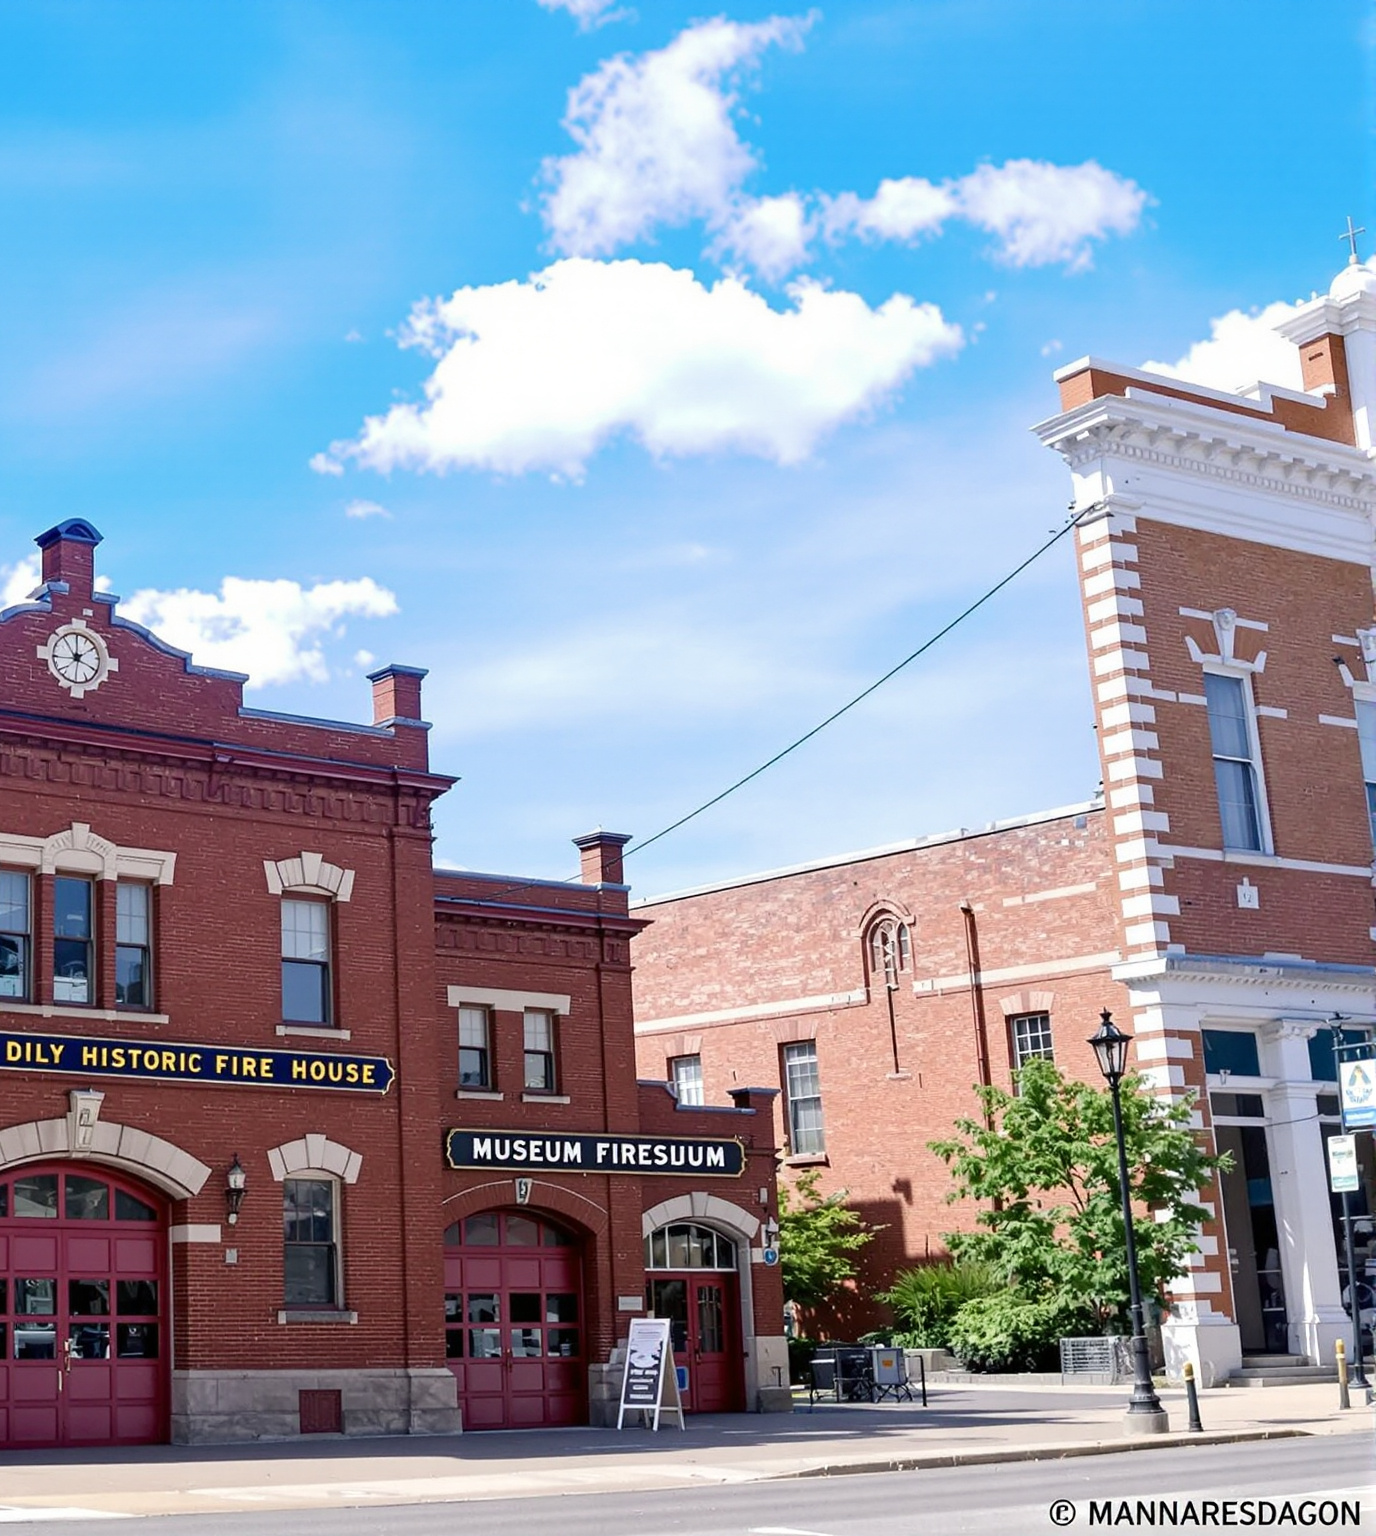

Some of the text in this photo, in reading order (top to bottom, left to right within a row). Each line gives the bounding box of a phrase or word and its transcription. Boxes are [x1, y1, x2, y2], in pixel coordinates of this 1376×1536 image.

[6, 1041, 65, 1064] DILY
[82, 1046, 202, 1073] HISTORIC
[216, 1055, 274, 1078] FIRE
[292, 1060, 375, 1084] HOUSE
[473, 1137, 582, 1164] MUSEUM
